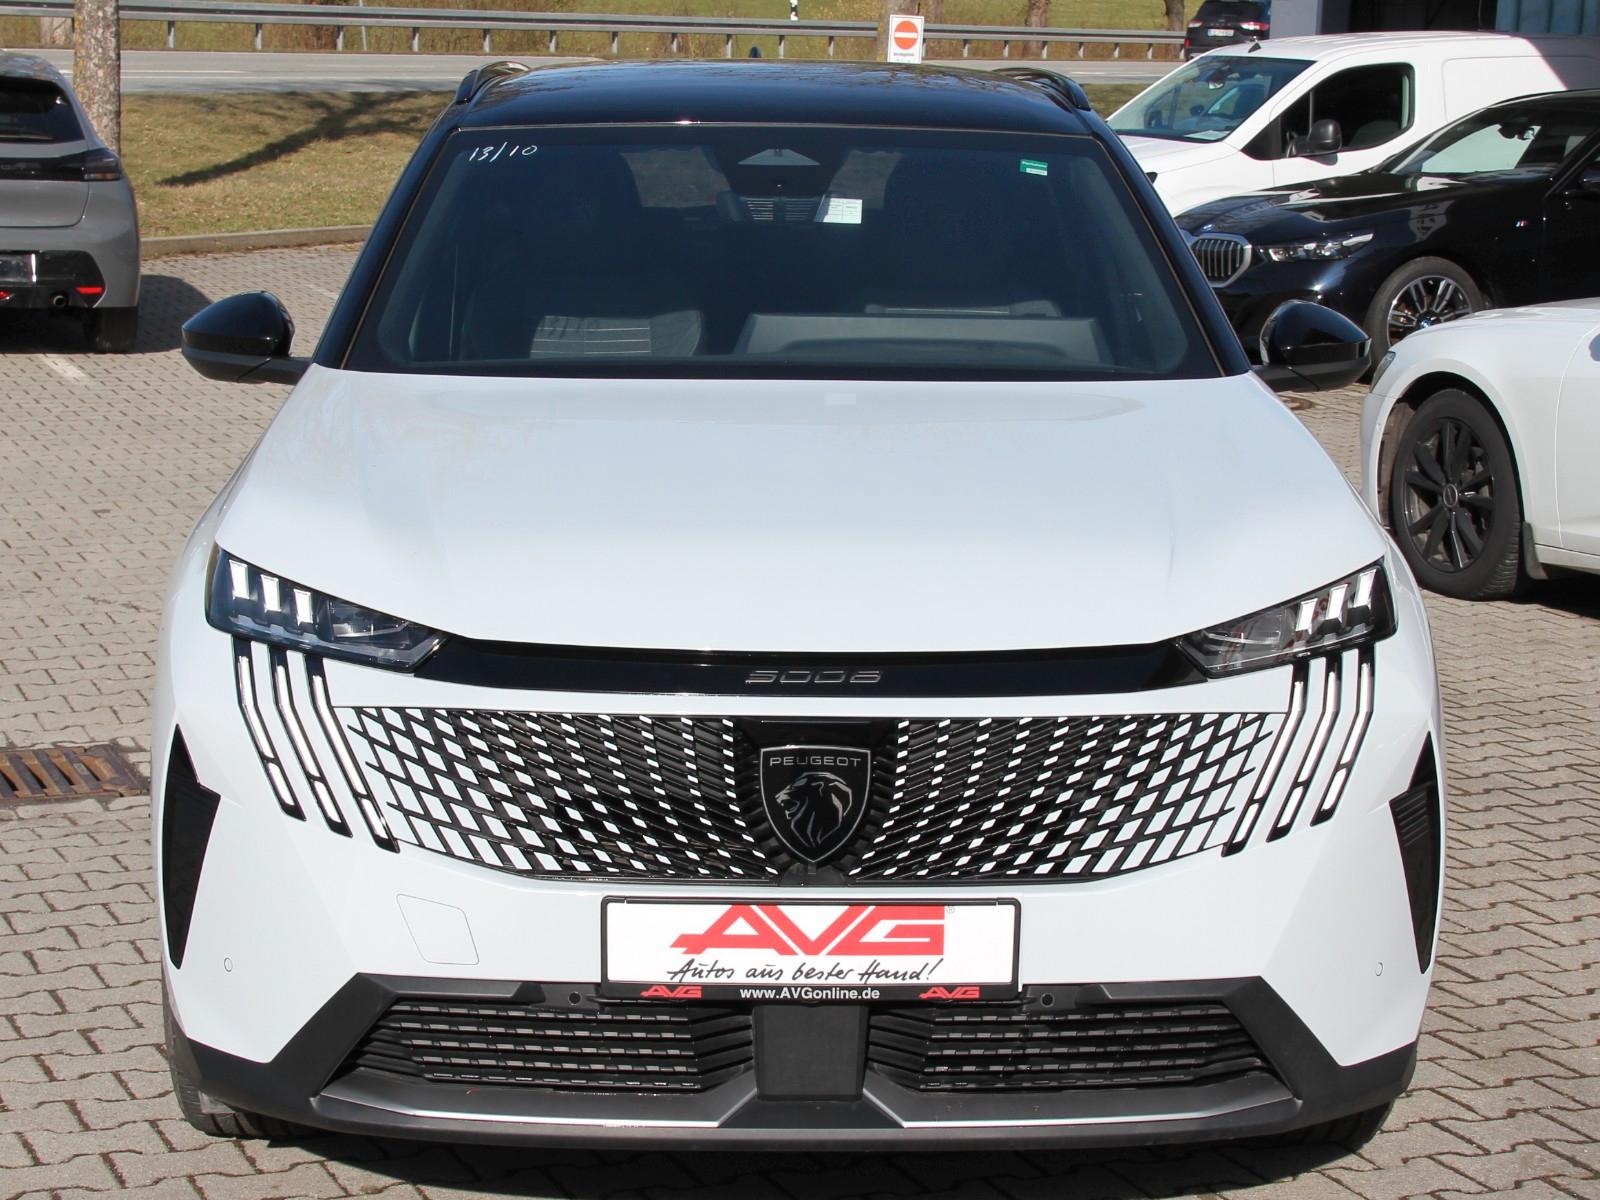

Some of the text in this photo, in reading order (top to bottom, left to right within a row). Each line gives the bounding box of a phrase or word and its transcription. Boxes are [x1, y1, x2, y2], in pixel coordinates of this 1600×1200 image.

[468, 141, 538, 162] 13/10
[769, 755, 861, 767] PEUGEOT
[669, 904, 945, 956] AVG
[667, 957, 944, 985] Autos aus bester Hand!
[640, 985, 980, 999] AVG www.AVGonline.de AVG
